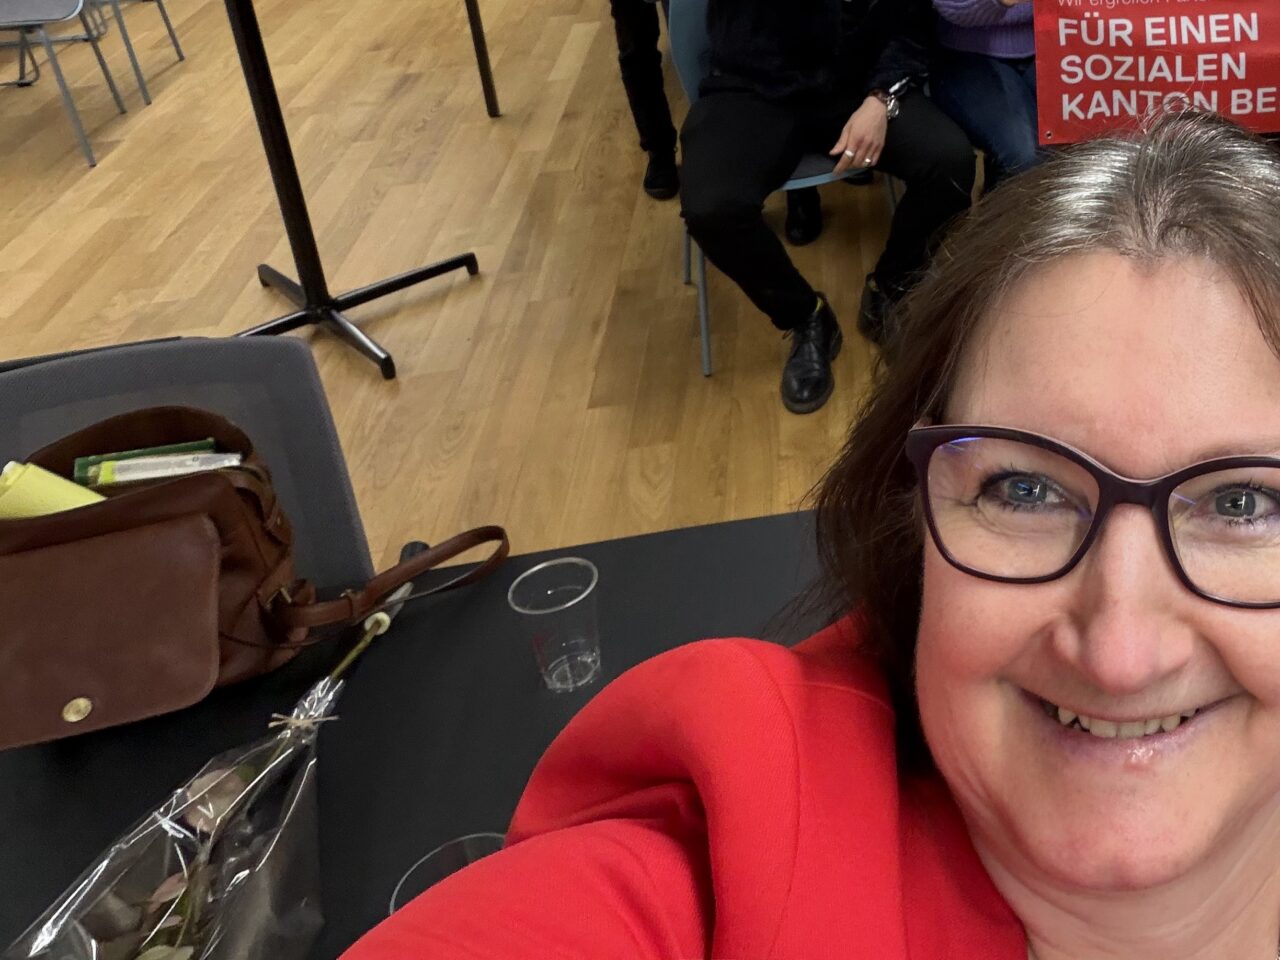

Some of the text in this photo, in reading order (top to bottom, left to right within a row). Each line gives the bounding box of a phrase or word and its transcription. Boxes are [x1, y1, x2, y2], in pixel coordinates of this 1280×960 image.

[1058, 12, 1259, 47] FÜR EINEN
[1060, 52, 1246, 85] SOZIALEN
[1062, 88, 1217, 121] KANTON
